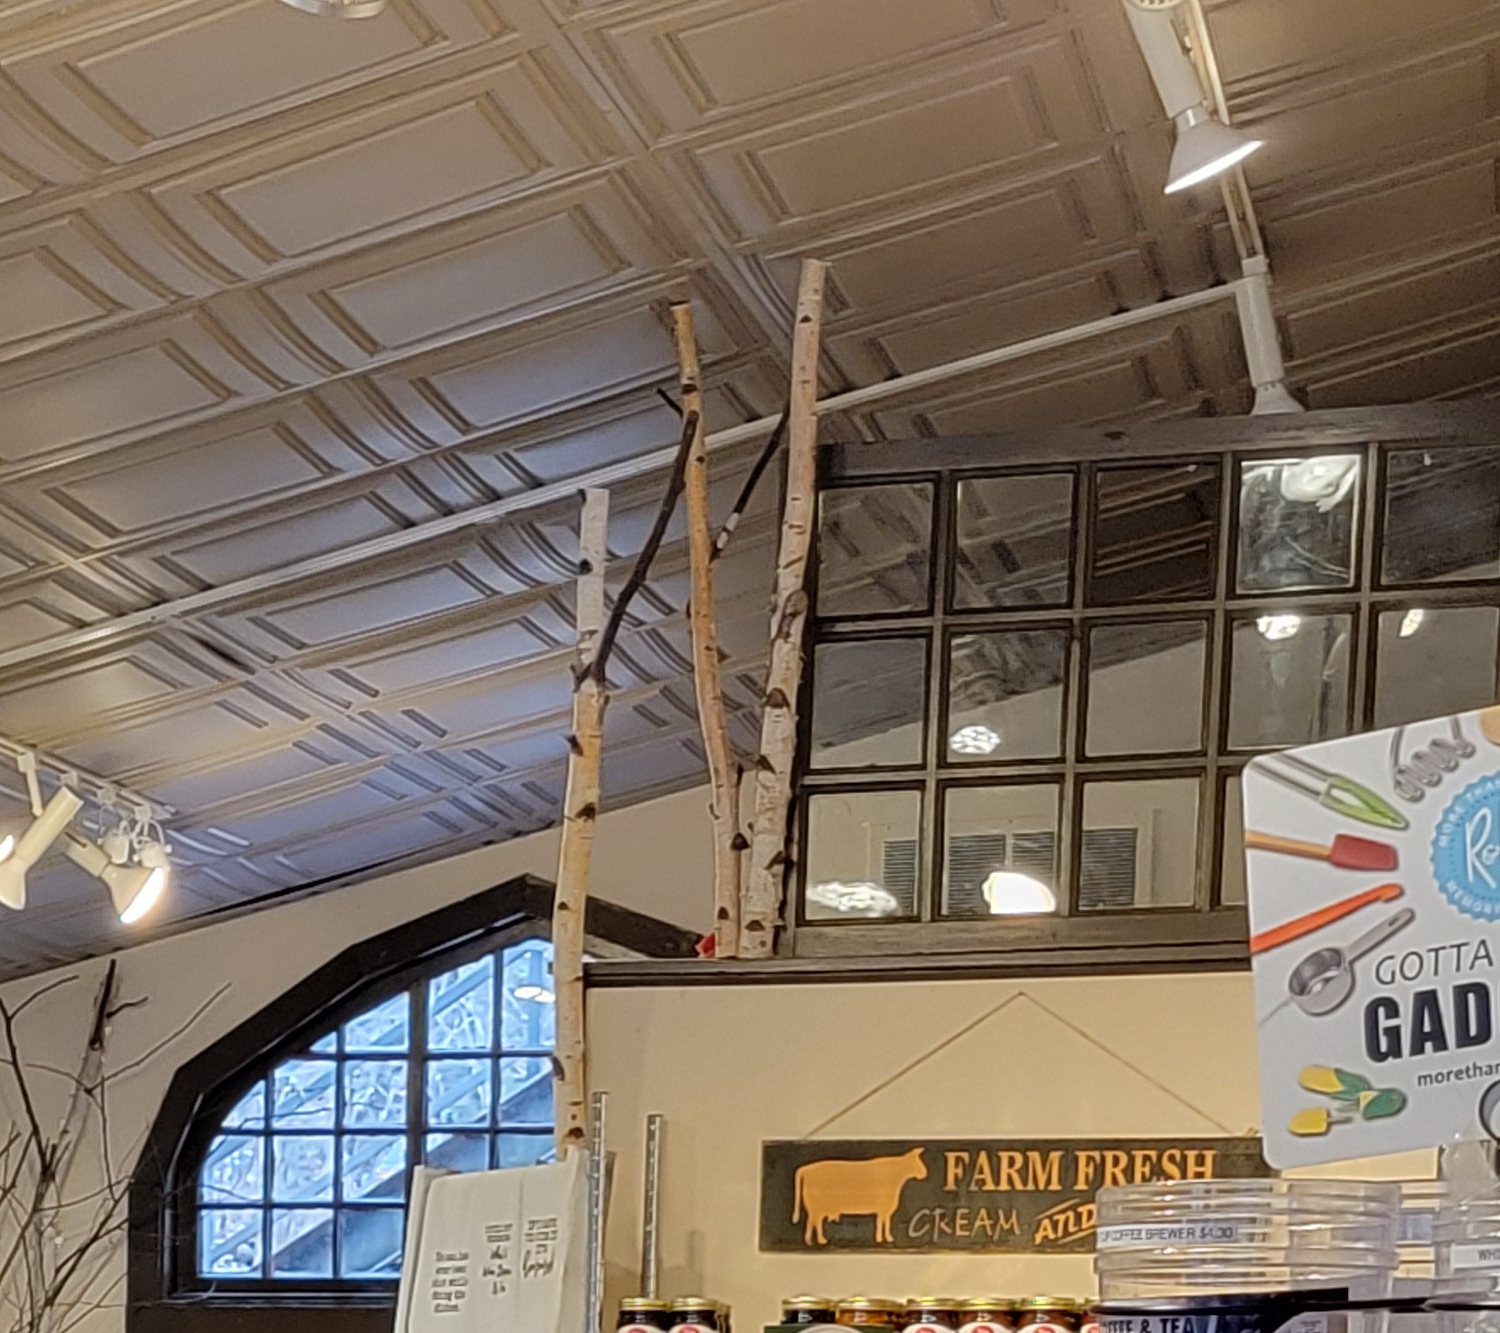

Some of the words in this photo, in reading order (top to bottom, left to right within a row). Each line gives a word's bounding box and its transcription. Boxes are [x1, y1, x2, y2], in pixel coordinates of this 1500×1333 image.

[1375, 938, 1495, 986] GOTTA
[944, 1149, 1062, 1191] FARM
[1073, 1148, 1217, 1191] FRESH
[908, 1206, 1021, 1243] CREAM
